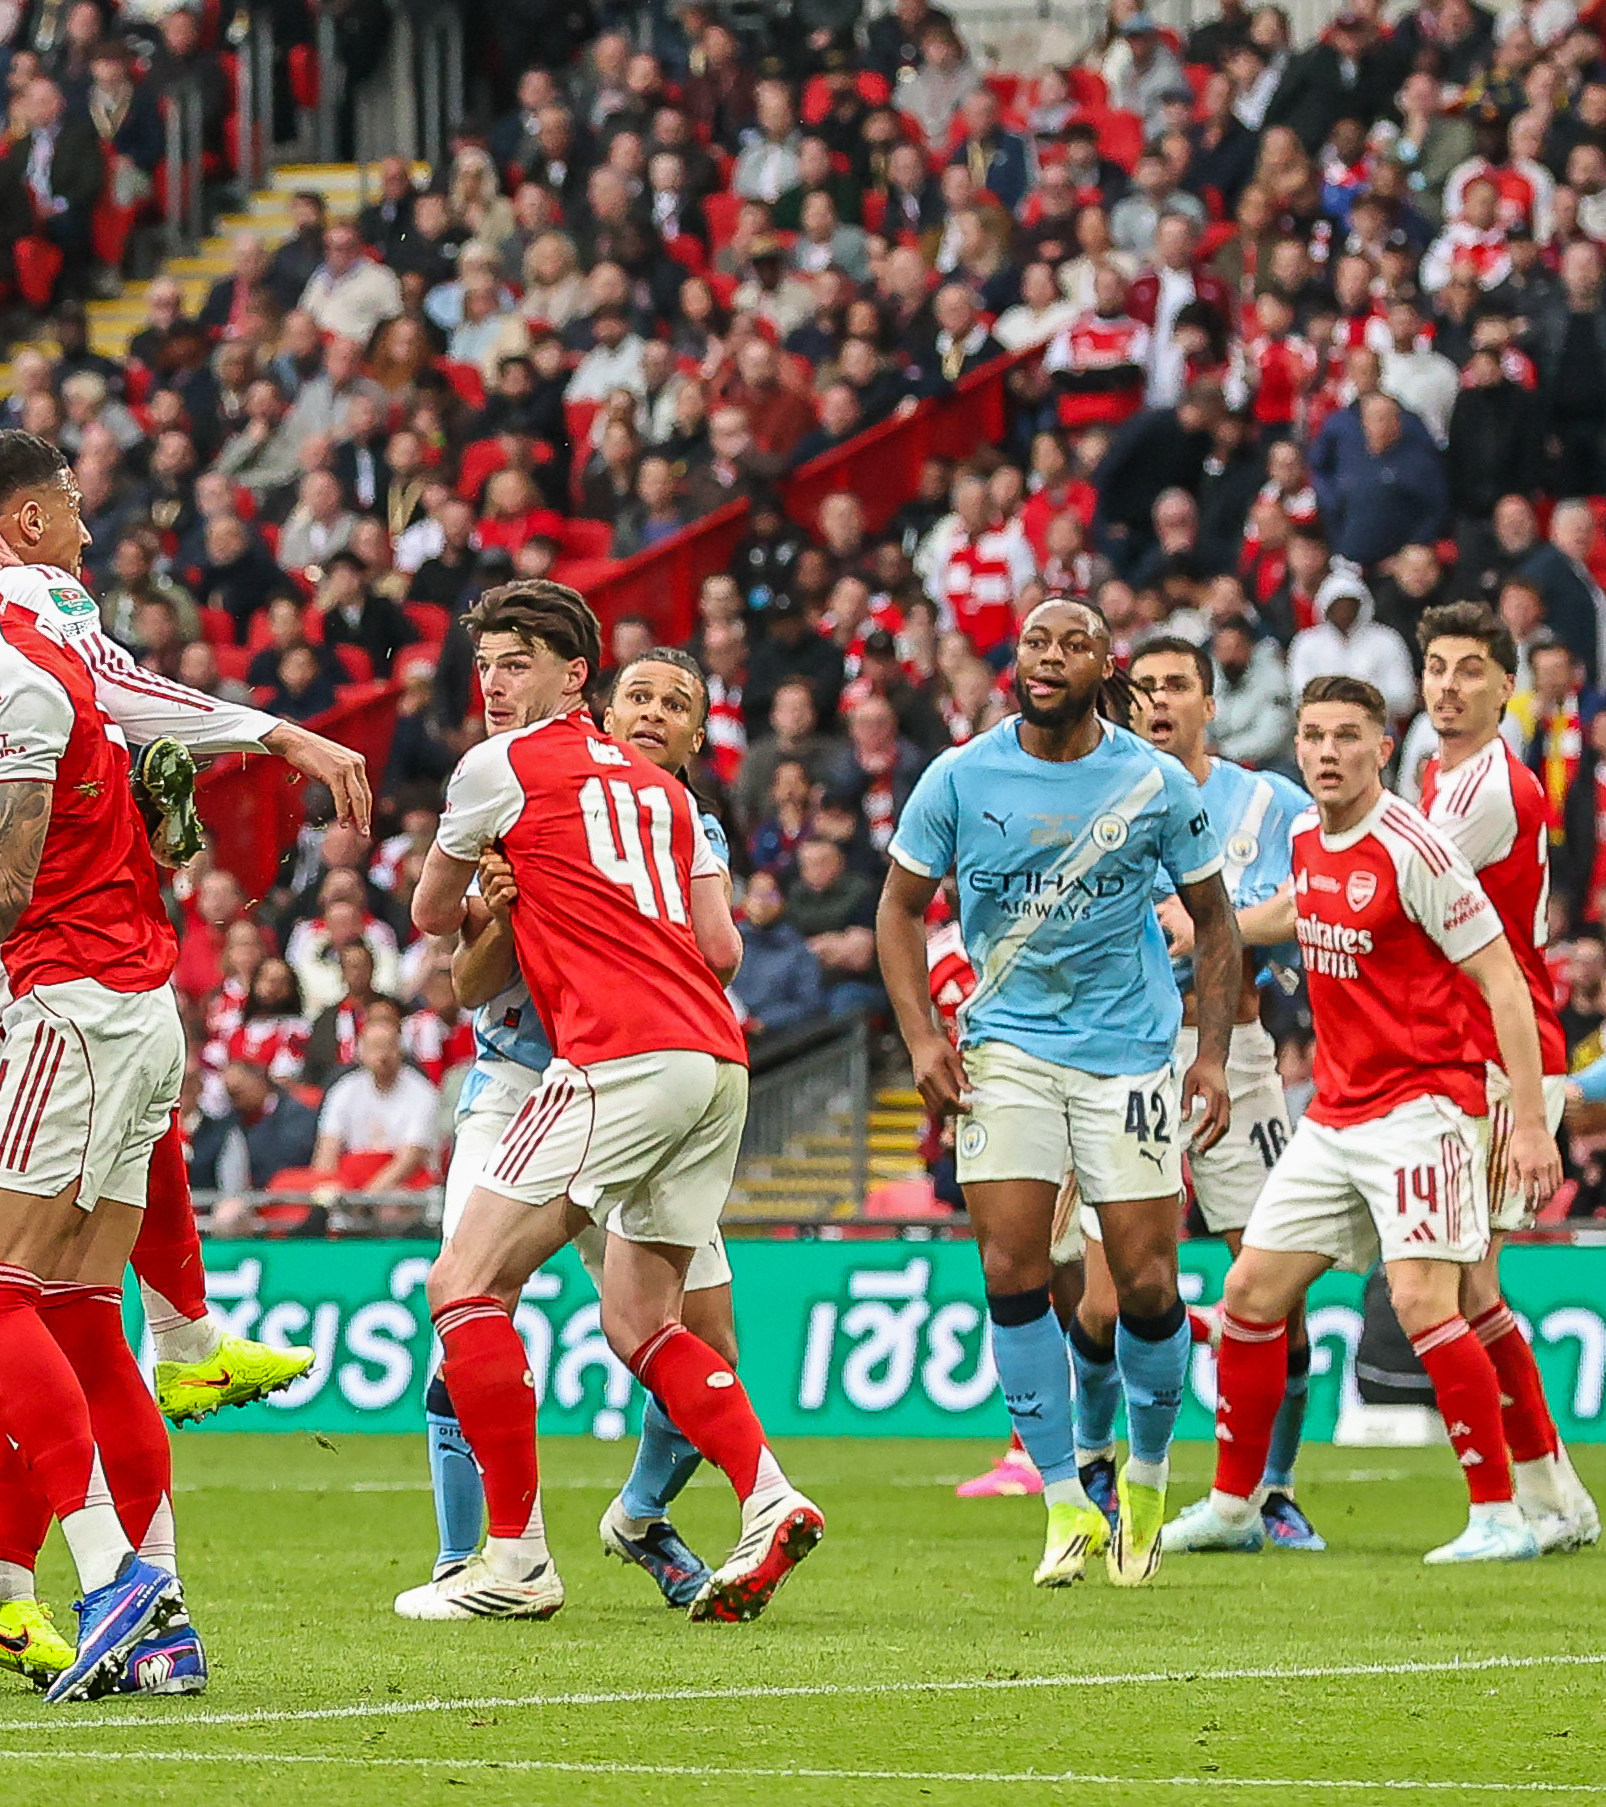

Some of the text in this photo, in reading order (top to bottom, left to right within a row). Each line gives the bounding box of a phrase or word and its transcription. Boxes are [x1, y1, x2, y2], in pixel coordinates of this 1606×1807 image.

[578, 776, 688, 926] 41
[969, 870, 1125, 899] ETIHAD
[1000, 898, 1092, 921] AIRWAYS
[1295, 912, 1374, 956] mirates
[1124, 1090, 1172, 1144] 42
[1393, 1164, 1439, 1215] 14
